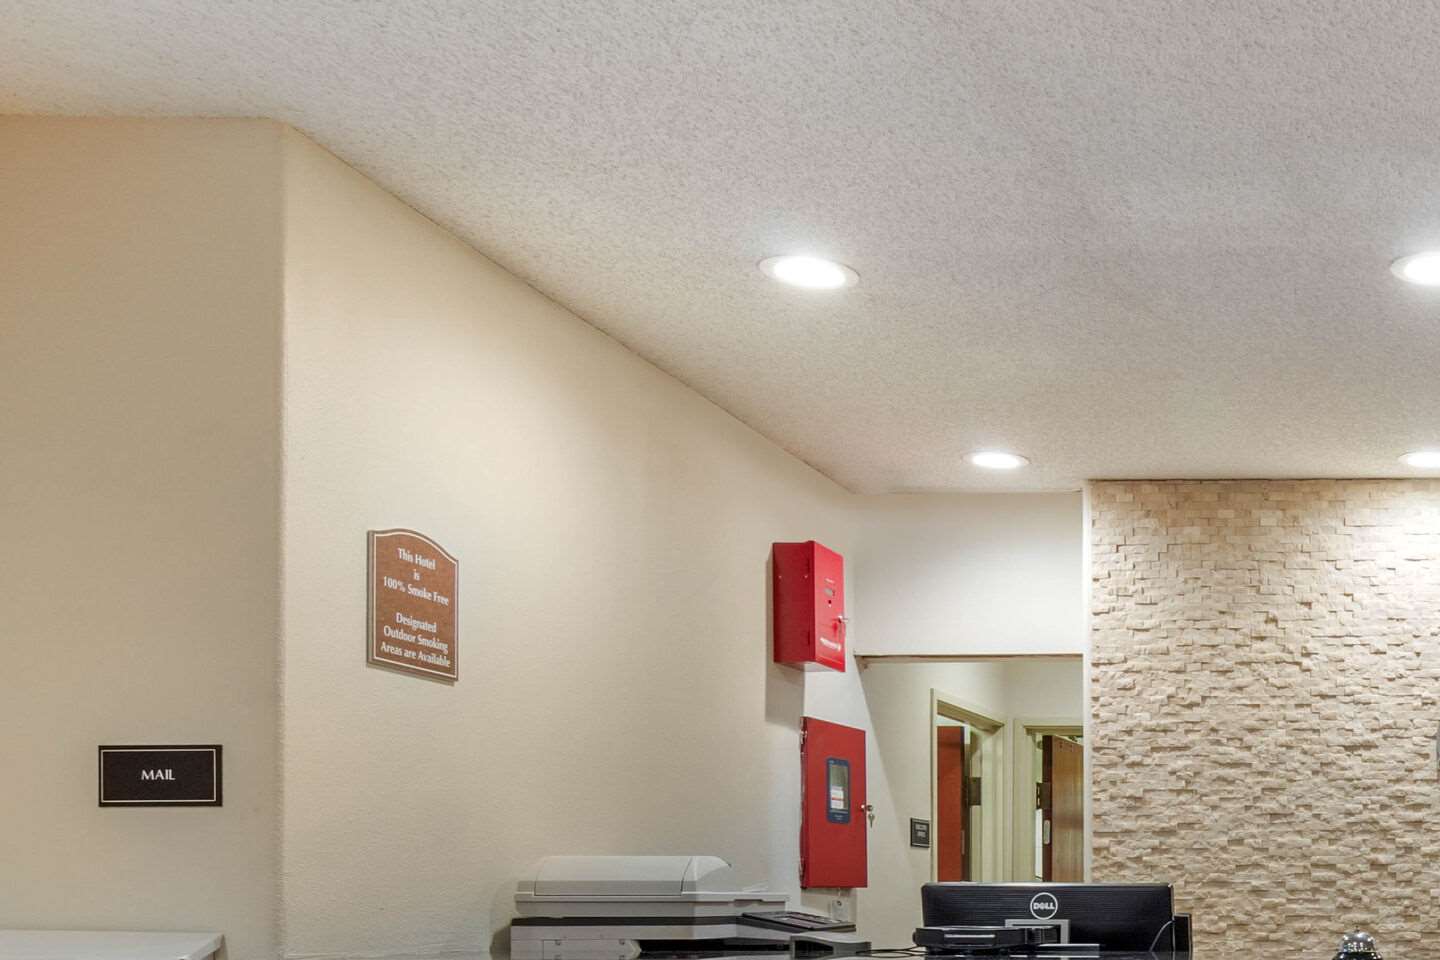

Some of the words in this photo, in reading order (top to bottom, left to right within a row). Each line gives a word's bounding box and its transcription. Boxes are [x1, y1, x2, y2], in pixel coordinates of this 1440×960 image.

[397, 548, 413, 563] This
[415, 554, 436, 570] Hotel
[413, 569, 420, 581] is
[384, 576, 405, 592] 100%
[408, 584, 432, 601] Smoke
[433, 592, 449, 606] Free
[396, 612, 437, 633] Designated
[384, 625, 416, 643] Outdoor
[417, 634, 449, 655] Smoking
[381, 641, 402, 656] Areas
[404, 649, 416, 660] are
[418, 651, 450, 667] Available
[141, 768, 176, 781] MAIL
[1033, 902, 1056, 910] DELL
